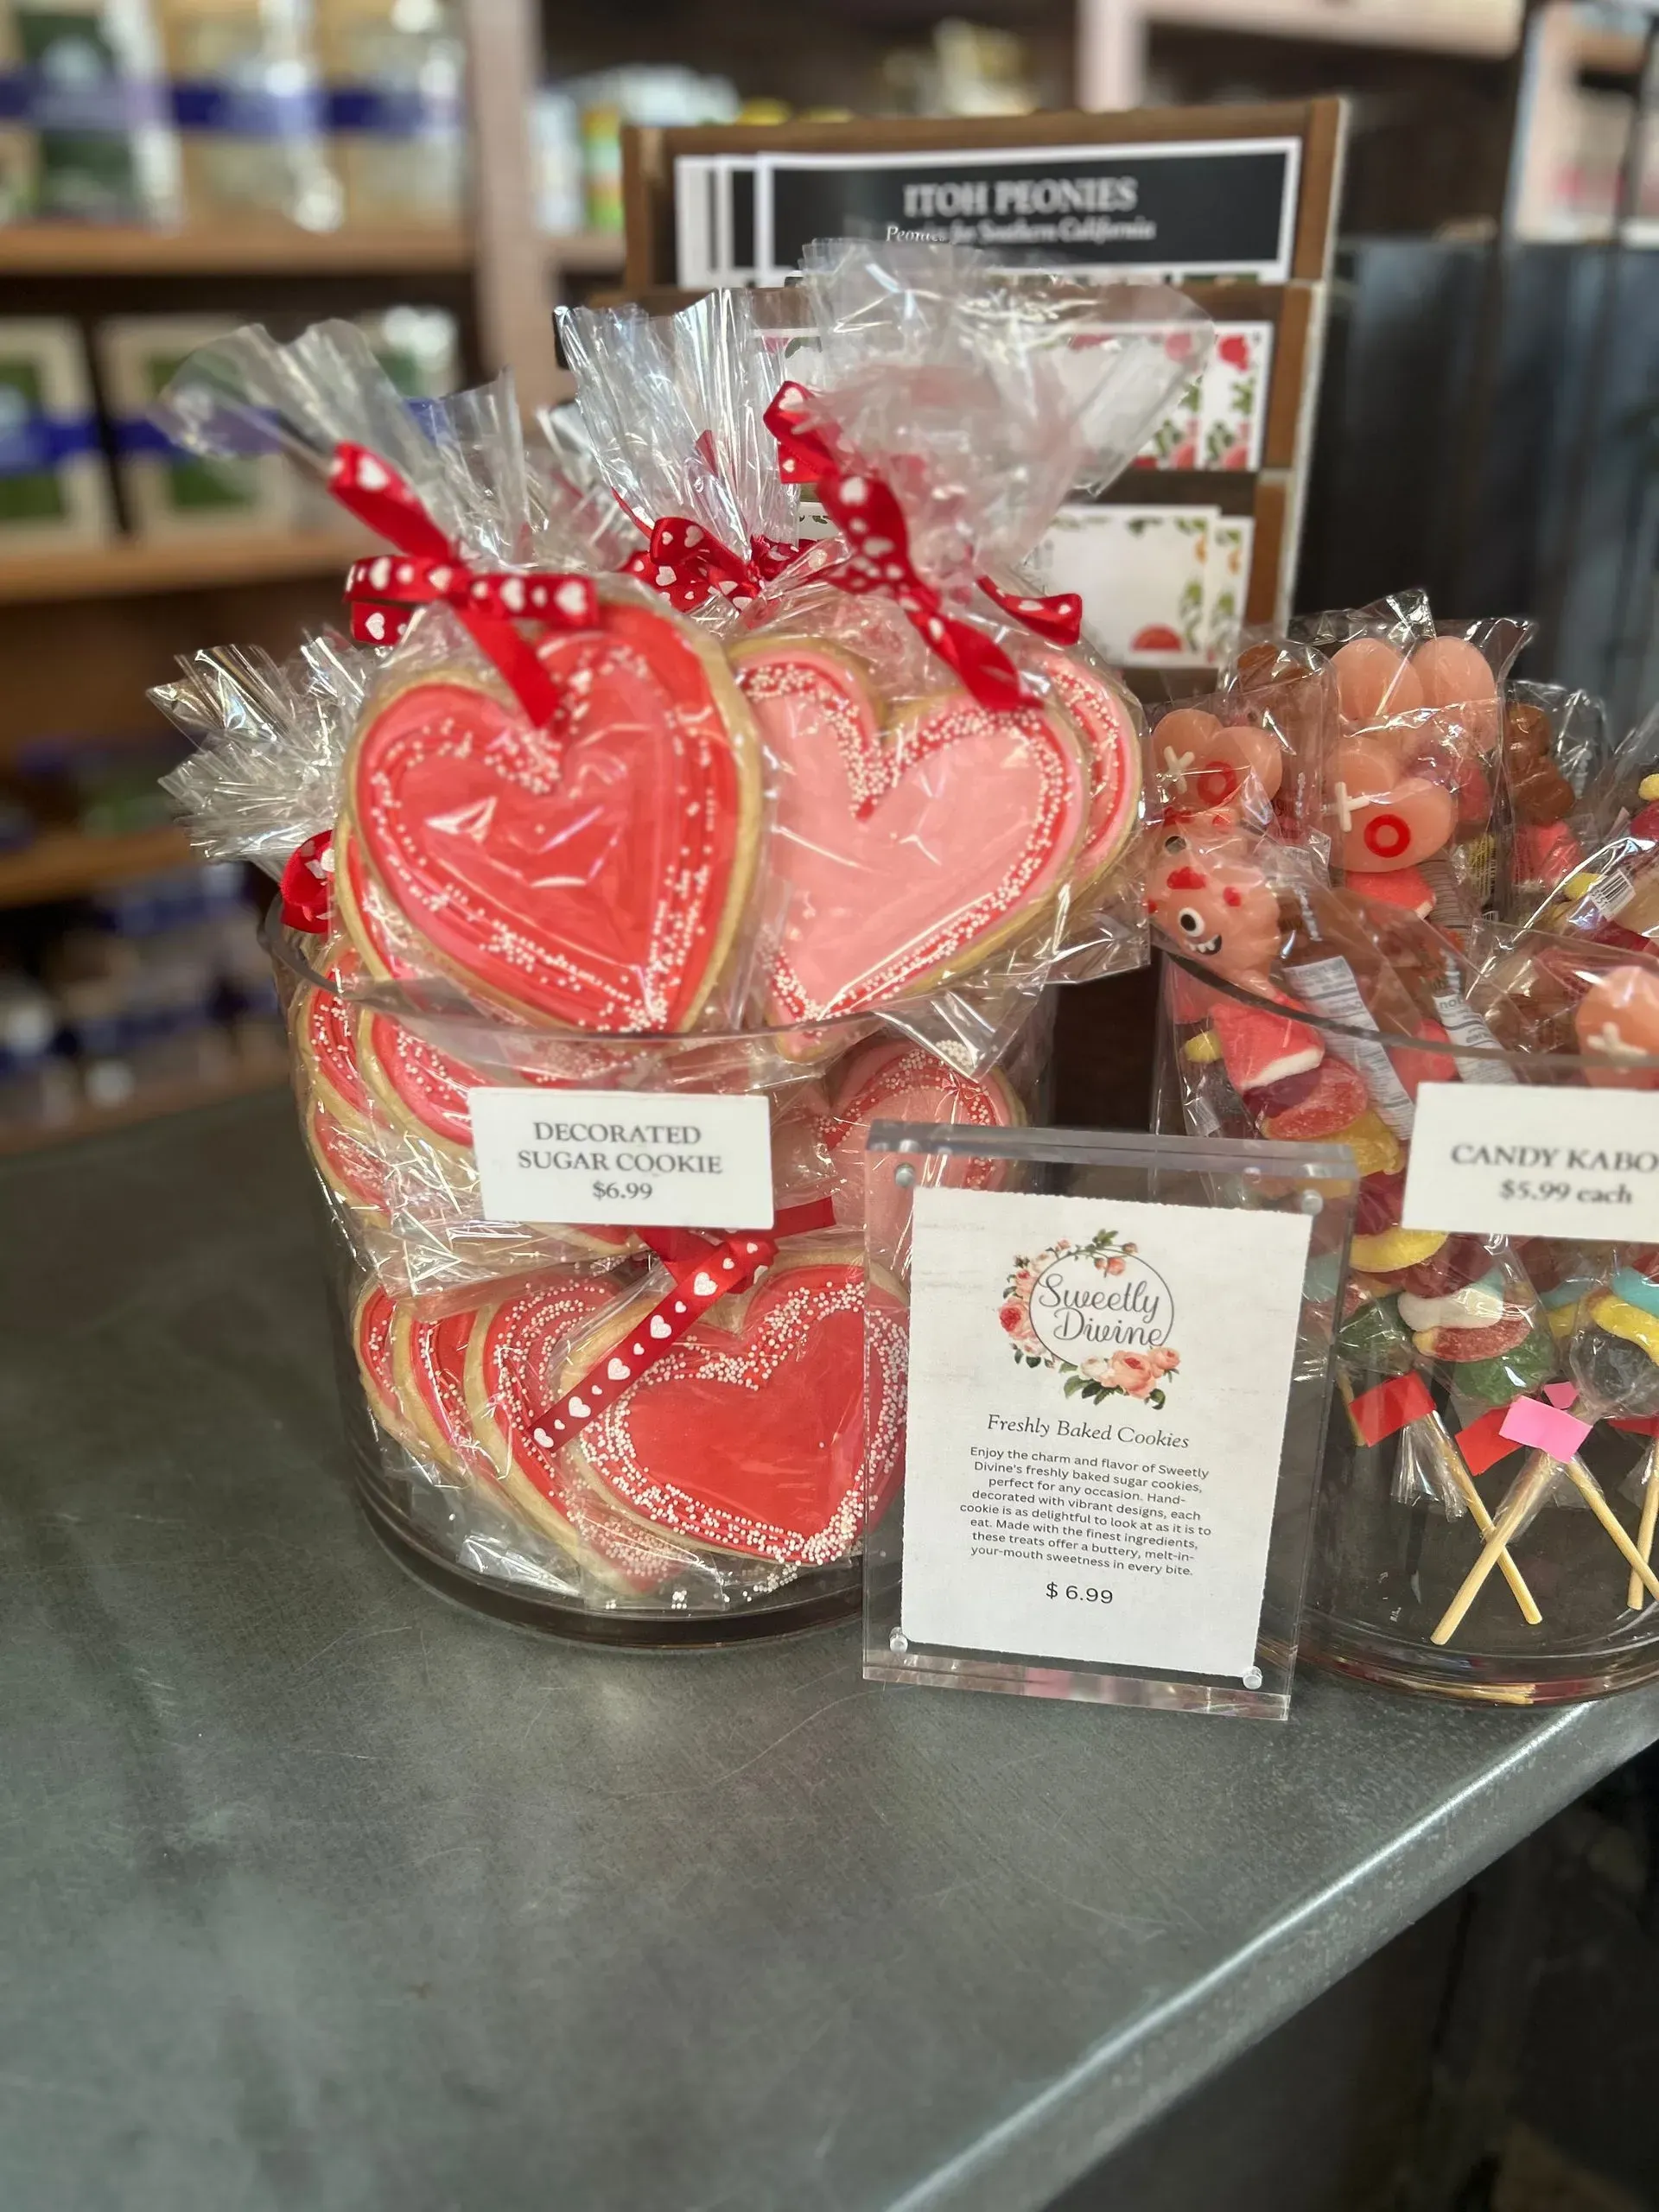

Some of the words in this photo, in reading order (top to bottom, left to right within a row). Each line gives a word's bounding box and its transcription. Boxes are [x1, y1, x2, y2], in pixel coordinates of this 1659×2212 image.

[903, 181, 988, 218] ITOH
[994, 175, 1138, 215] PEONIES
[977, 219, 1058, 245] Southern
[1058, 216, 1157, 246] California
[532, 1122, 702, 1145] DECORATED
[518, 1150, 609, 1171] SUGAR
[616, 1152, 723, 1174] COOKIE
[1450, 1142, 1558, 1168] CANDY
[592, 1179, 653, 1201] $6.99
[1499, 1178, 1571, 1202] $5.99
[1576, 1183, 1633, 1205] each
[1038, 1274, 1160, 1324] Sweetly
[1052, 1306, 1164, 1347] Divine
[987, 1413, 1051, 1437] Freshly
[1057, 1420, 1112, 1440] Baked
[1117, 1426, 1190, 1449] Cookies
[970, 1446, 1004, 1459] Enjoy
[1007, 1450, 1028, 1459] the
[1032, 1452, 1071, 1464] charm
[1074, 1457, 1097, 1466] and
[1102, 1459, 1139, 1471] flavor
[1141, 1464, 1156, 1473] of
[1158, 1465, 1209, 1479] Sweetly
[975, 1461, 1022, 1474] Divine's
[1027, 1465, 1069, 1480] freshly
[1072, 1470, 1110, 1483] baked
[1113, 1476, 1147, 1488] sugar
[1151, 1480, 1202, 1493] cookies,
[972, 1490, 1035, 1503] decorated
[1039, 1496, 1065, 1507] with
[1068, 1498, 1114, 1512] vibrant
[1116, 1504, 1166, 1520] designs,
[1171, 1511, 1201, 1521] each
[988, 1478, 1034, 1490] perfect
[1037, 1480, 1056, 1491] for
[1058, 1484, 1081, 1496] any
[1084, 1487, 1143, 1502] occasion.
[1147, 1493, 1185, 1504] Hand-
[960, 1501, 999, 1515] cookie
[1002, 1505, 1012, 1515] is
[1032, 1509, 1090, 1523] delightful
[1095, 1516, 1107, 1525] to
[1110, 1517, 1137, 1529] look
[1140, 1522, 1153, 1531] at
[1173, 1523, 1181, 1534] it
[1185, 1524, 1195, 1535] is
[1198, 1527, 1211, 1535] to
[970, 1519, 992, 1528] eat.
[996, 1519, 1030, 1531] Made
[1033, 1523, 1058, 1534] with
[1063, 1527, 1083, 1536] the
[1086, 1529, 1122, 1541] finest
[1124, 1533, 1198, 1549] ingredients,
[972, 1532, 1006, 1542] these
[1009, 1535, 1045, 1546] treats
[1048, 1539, 1078, 1549] offer
[1091, 1543, 1141, 1559] buttery,
[1145, 1551, 1194, 1561] melt-in-
[971, 1546, 1043, 1560] your-mouth
[1046, 1553, 1110, 1567] sweetness
[1113, 1559, 1124, 1570] in
[1128, 1562, 1162, 1575] every
[1166, 1565, 1193, 1576] bite.
[1046, 1581, 1058, 1599] $
[1065, 1585, 1113, 1604] 6.99
